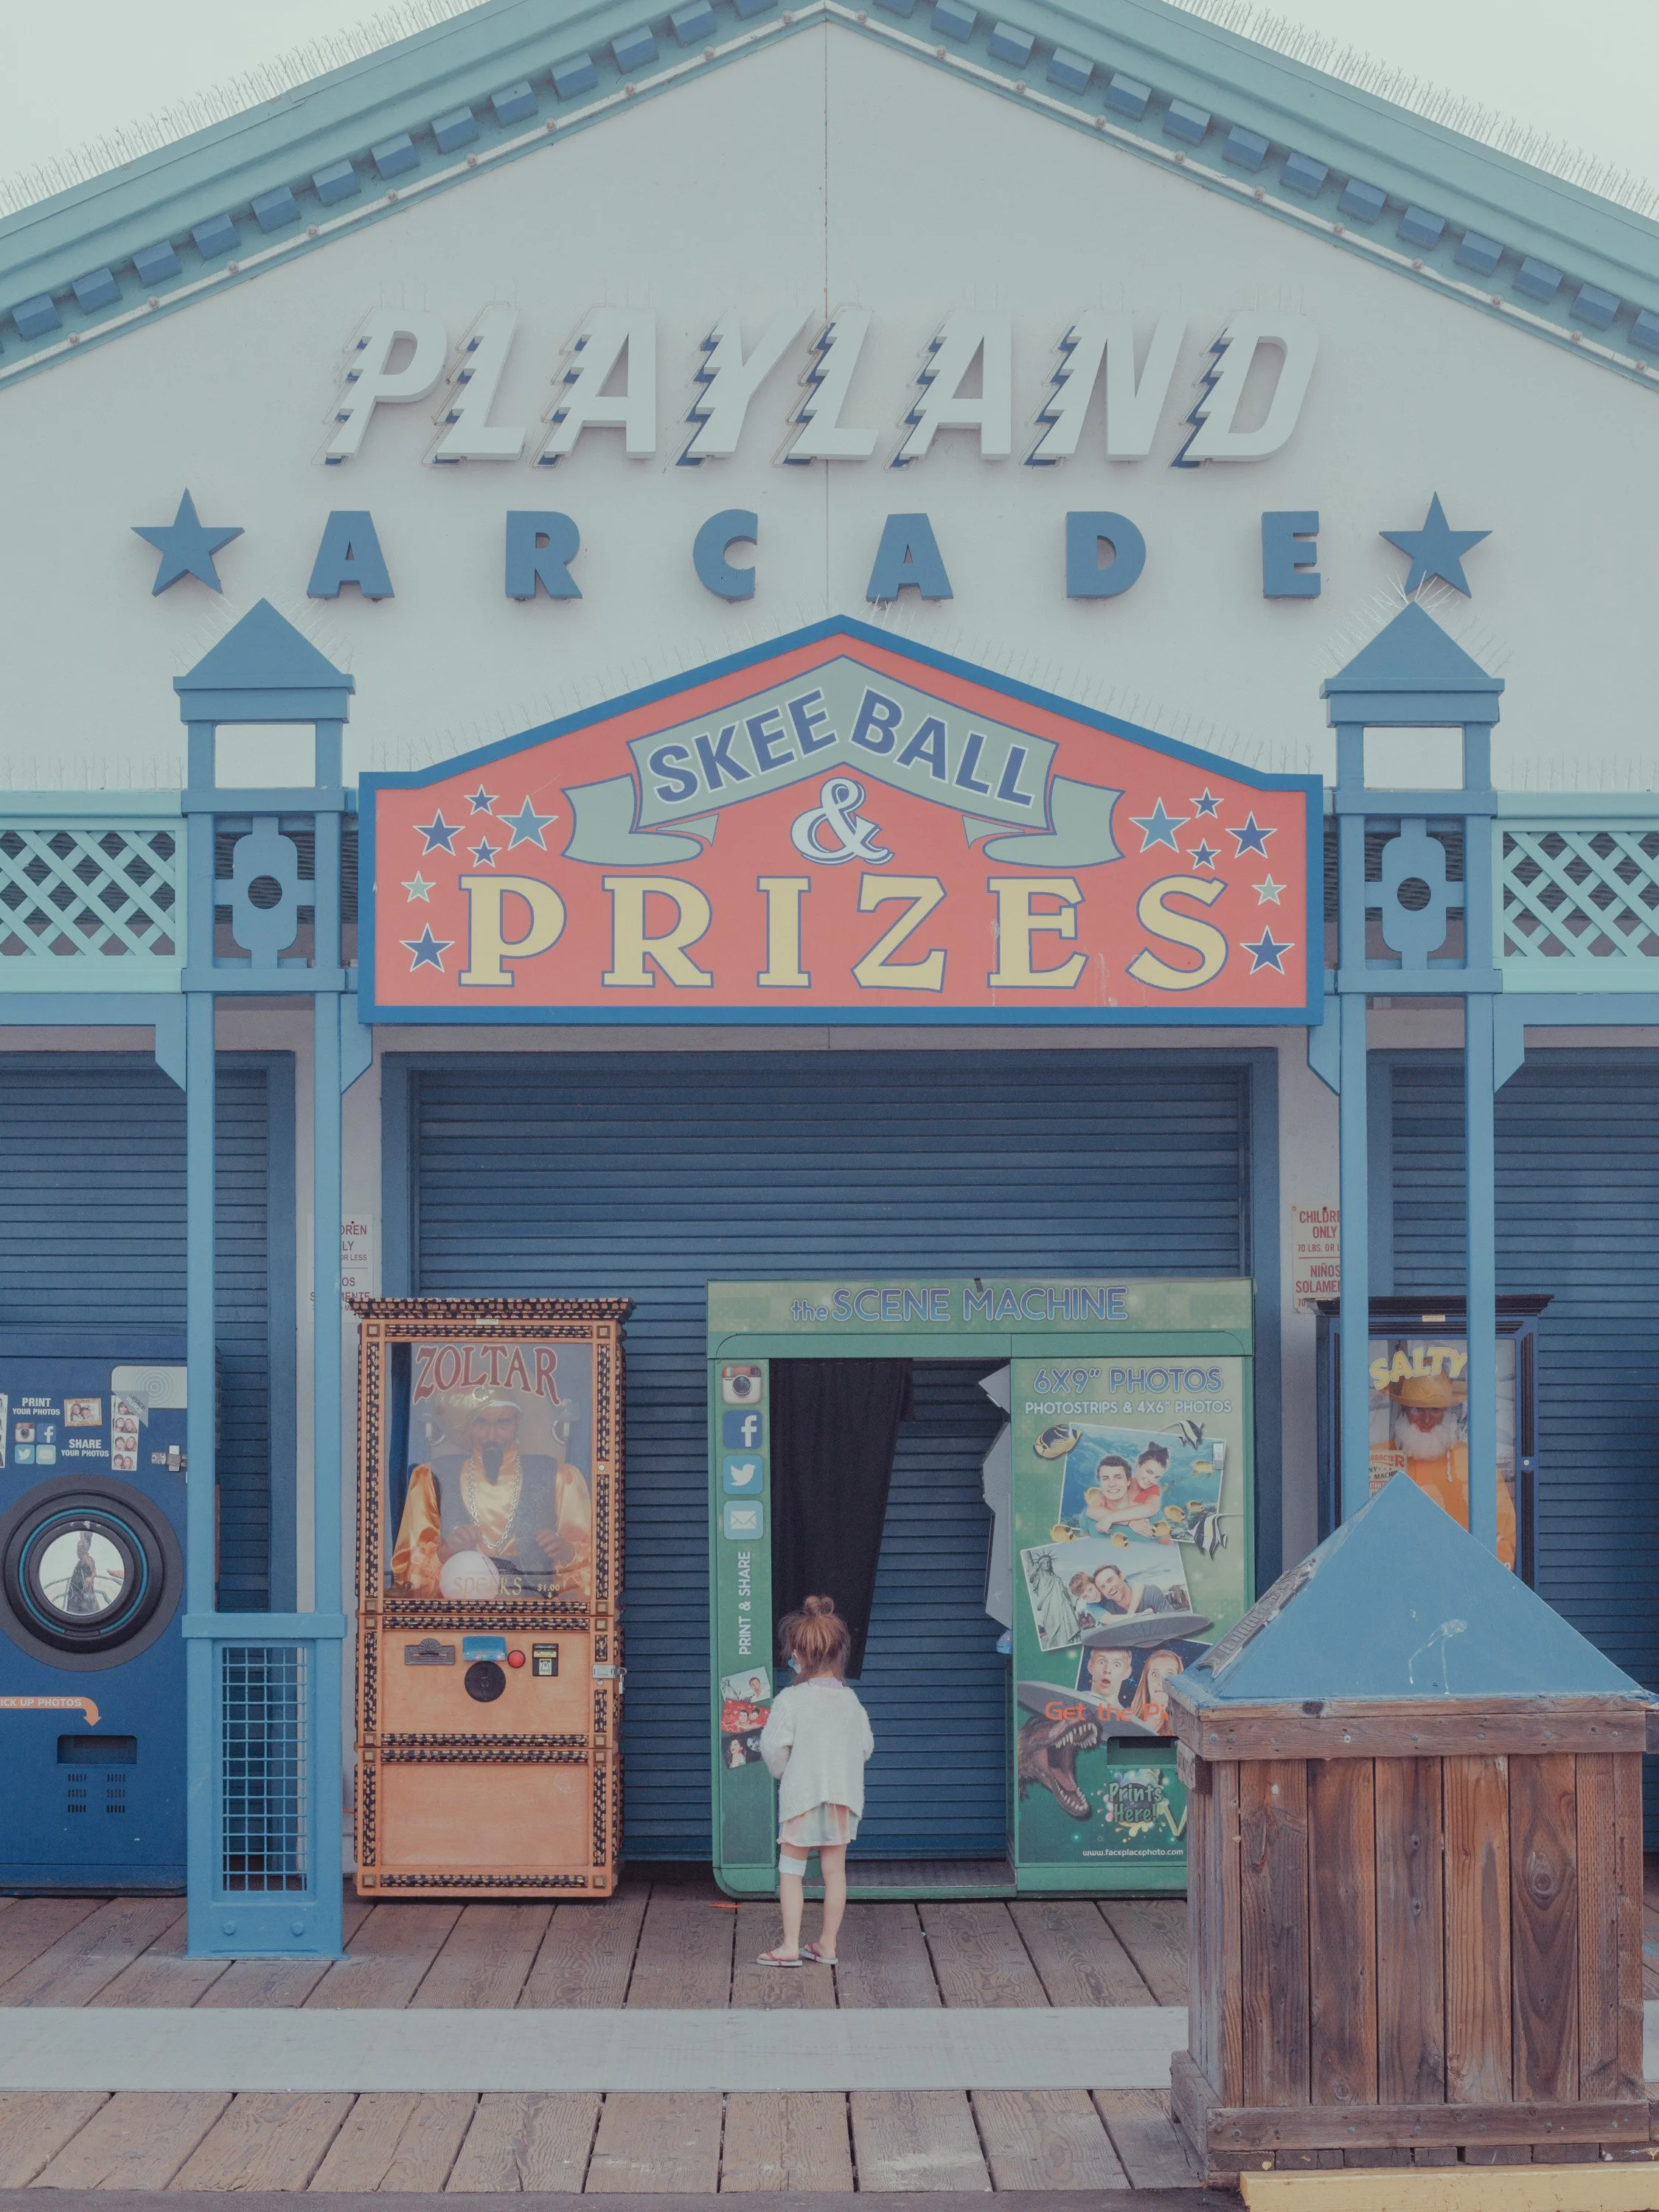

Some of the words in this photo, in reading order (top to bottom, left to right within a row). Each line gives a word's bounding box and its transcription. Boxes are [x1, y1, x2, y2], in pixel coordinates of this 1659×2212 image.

[324, 307, 1320, 469] PLAYLAND
[307, 509, 1321, 602] ARCADE
[647, 686, 839, 805] SKEE
[848, 685, 1036, 809] BALL
[790, 776, 895, 866] &
[458, 872, 1230, 993] PRIZES
[1299, 1210, 1340, 1223] CHILDR
[1312, 1226, 1337, 1239] ONLY
[1298, 1244, 1305, 1252] 70
[1308, 1244, 1322, 1252] LBS.
[1295, 1281, 1340, 1293] SOLAME
[790, 1299, 829, 1321] the
[832, 1287, 950, 1321] SCENE
[962, 1287, 1127, 1321] MACHINE
[413, 1343, 561, 1406] ZOLTAR
[1369, 1346, 1467, 1391] SALTY
[1110, 1367, 1222, 1394] PHOTOS
[22, 1397, 51, 1407] PRINT
[32, 1408, 60, 1416] PHOTOS
[1025, 1401, 1118, 1415] PHOTOSTRIPS
[1122, 1401, 1133, 1414] &
[1175, 1400, 1232, 1414] PHOTOS
[61, 1450, 79, 1458] YOUR
[81, 1450, 109, 1458] PHOTOS
[69, 1439, 101, 1449] SHARE
[738, 1551, 751, 1597] SHARE
[537, 1583, 560, 1592] $1.00
[739, 1601, 751, 1611] &
[738, 1615, 751, 1655] PRINT
[20, 1698, 34, 1706] UP
[38, 1698, 82, 1707] PHOTOS
[1045, 1700, 1086, 1722] Get
[1096, 1703, 1133, 1722] the
[1109, 1782, 1164, 1803] Prints
[1113, 1803, 1158, 1823] Here!
[1082, 1848, 1184, 1857] www.faceplacephoto.com
